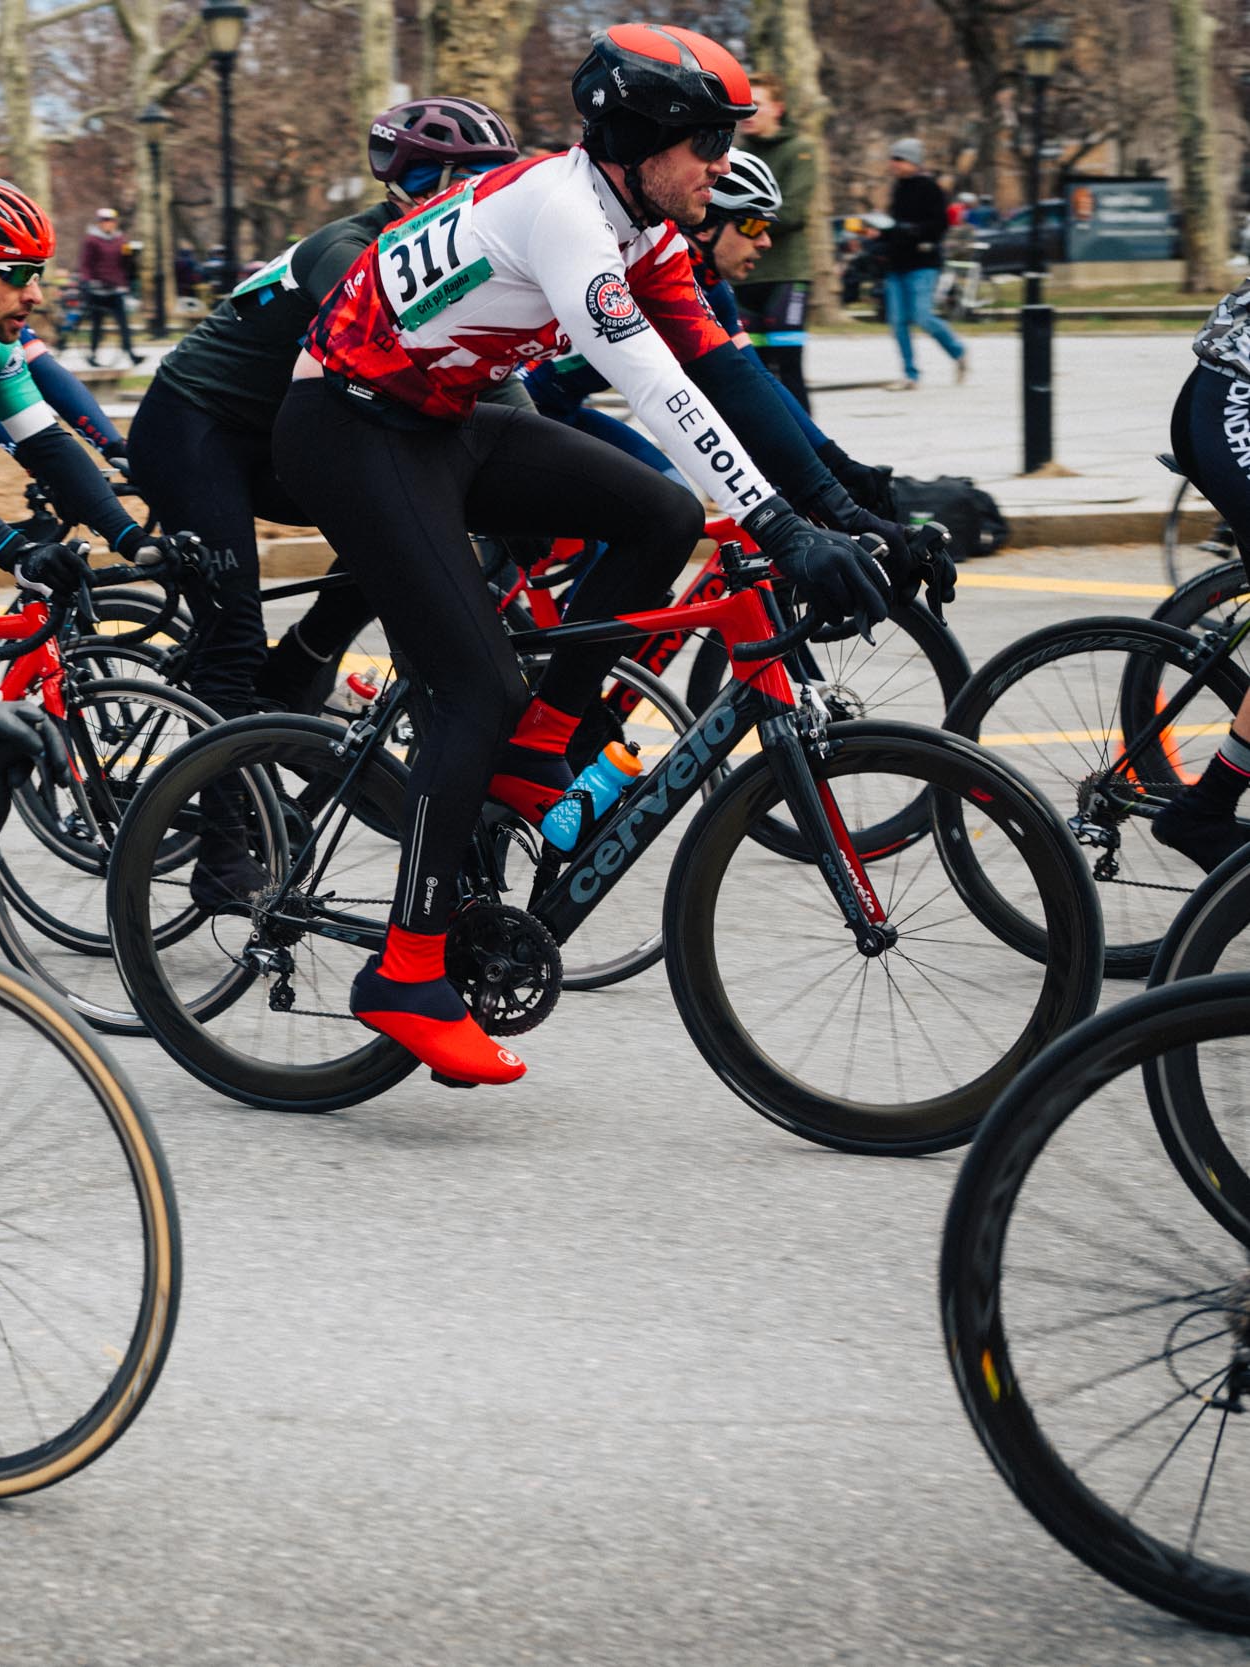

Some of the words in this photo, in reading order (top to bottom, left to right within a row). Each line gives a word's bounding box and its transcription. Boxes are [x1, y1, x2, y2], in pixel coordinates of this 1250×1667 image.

[390, 207, 461, 303] 317
[416, 298, 433, 315] Crit
[443, 273, 471, 295] Rapha
[588, 275, 605, 315] CENTURY
[610, 324, 642, 340] FOUNDED
[665, 389, 705, 433] BE
[693, 426, 762, 508] BOLD
